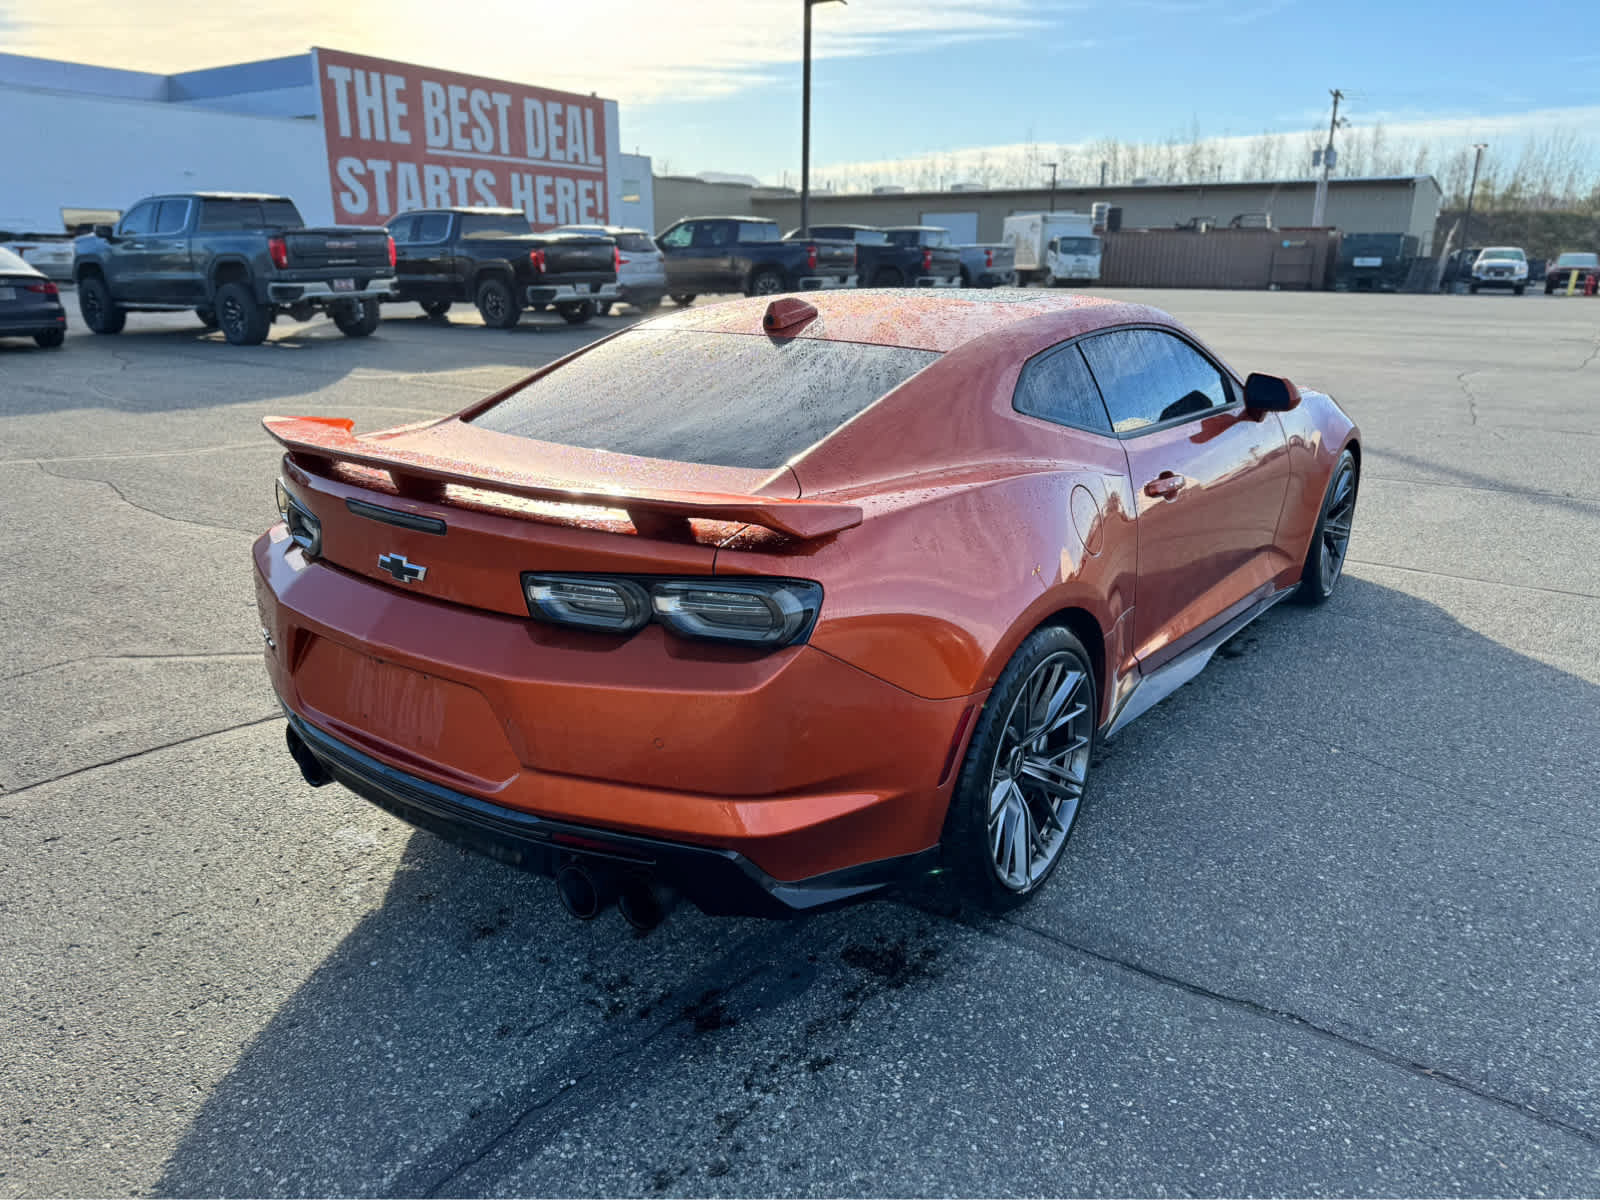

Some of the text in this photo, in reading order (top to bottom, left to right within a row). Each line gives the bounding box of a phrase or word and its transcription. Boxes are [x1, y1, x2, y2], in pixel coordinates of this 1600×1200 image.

[327, 64, 603, 166] THE BEST DEAL
[336, 156, 605, 225] STARTS HERE!
